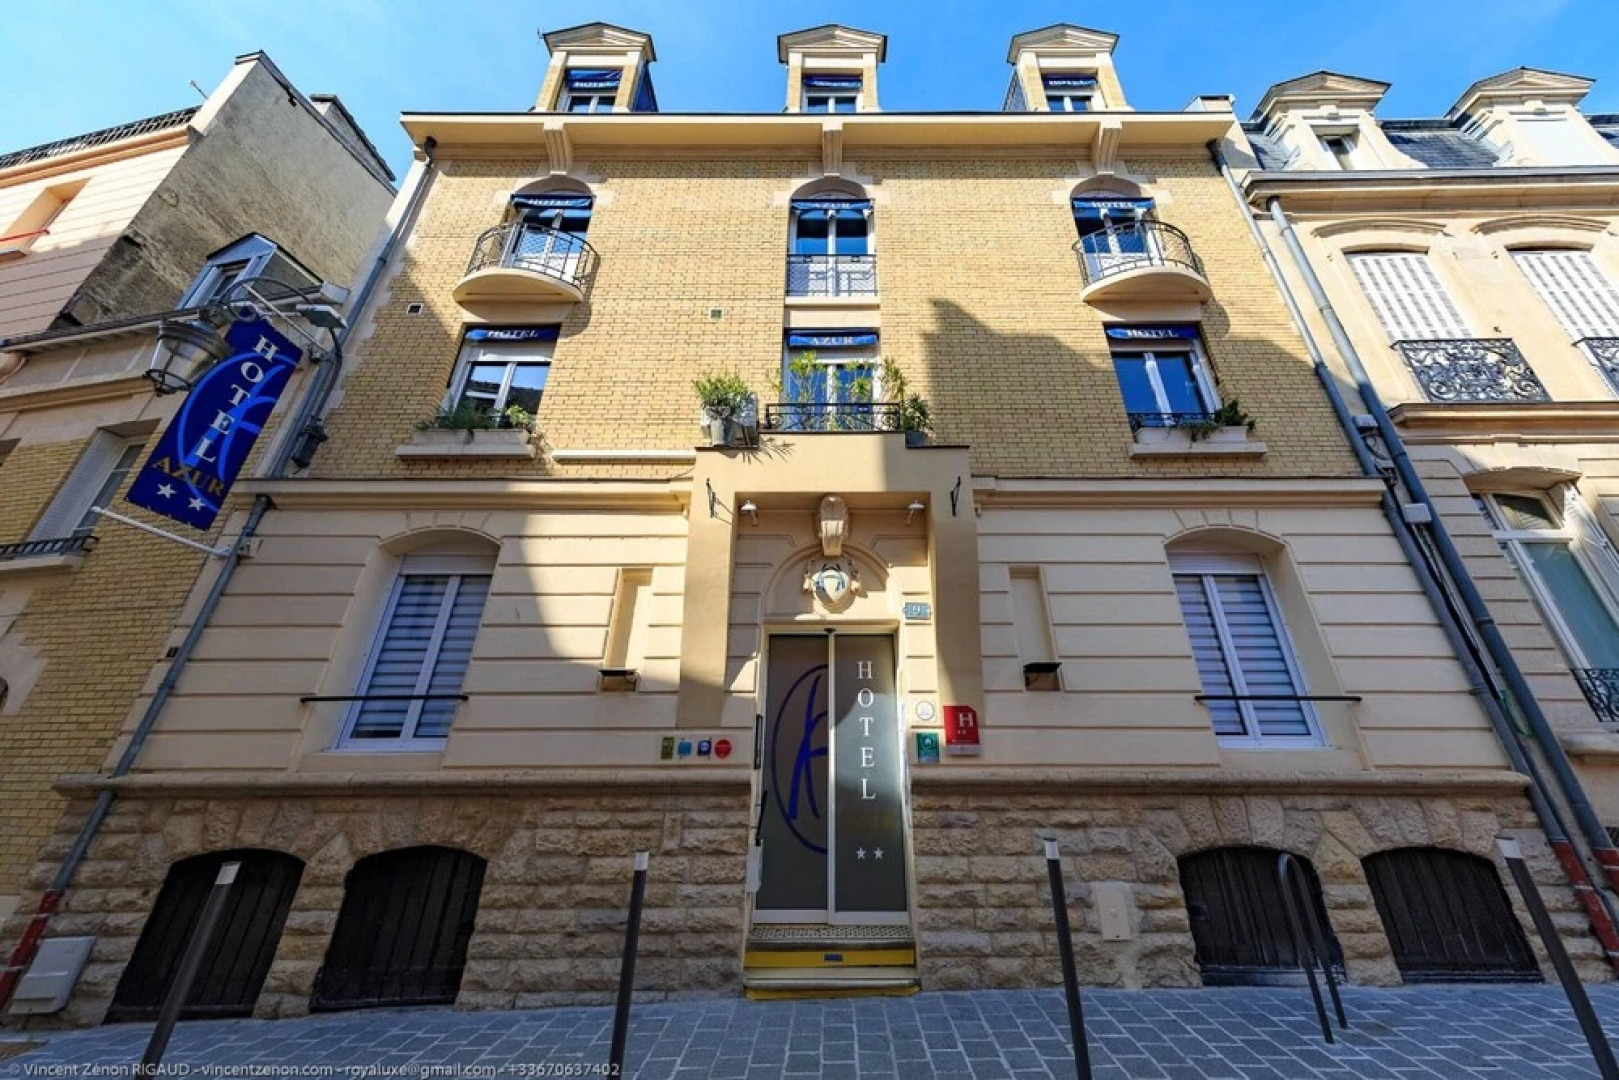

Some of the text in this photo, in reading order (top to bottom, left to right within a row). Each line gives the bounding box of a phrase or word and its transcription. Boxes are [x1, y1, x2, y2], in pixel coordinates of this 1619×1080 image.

[487, 329, 539, 338] HOTEL
[811, 336, 853, 345] AZUR
[1126, 329, 1178, 338] HOTEL
[195, 335, 279, 462] HOTEL
[153, 456, 225, 497] AZUR
[959, 712, 974, 728] H
[857, 661, 877, 799] HOTEL
